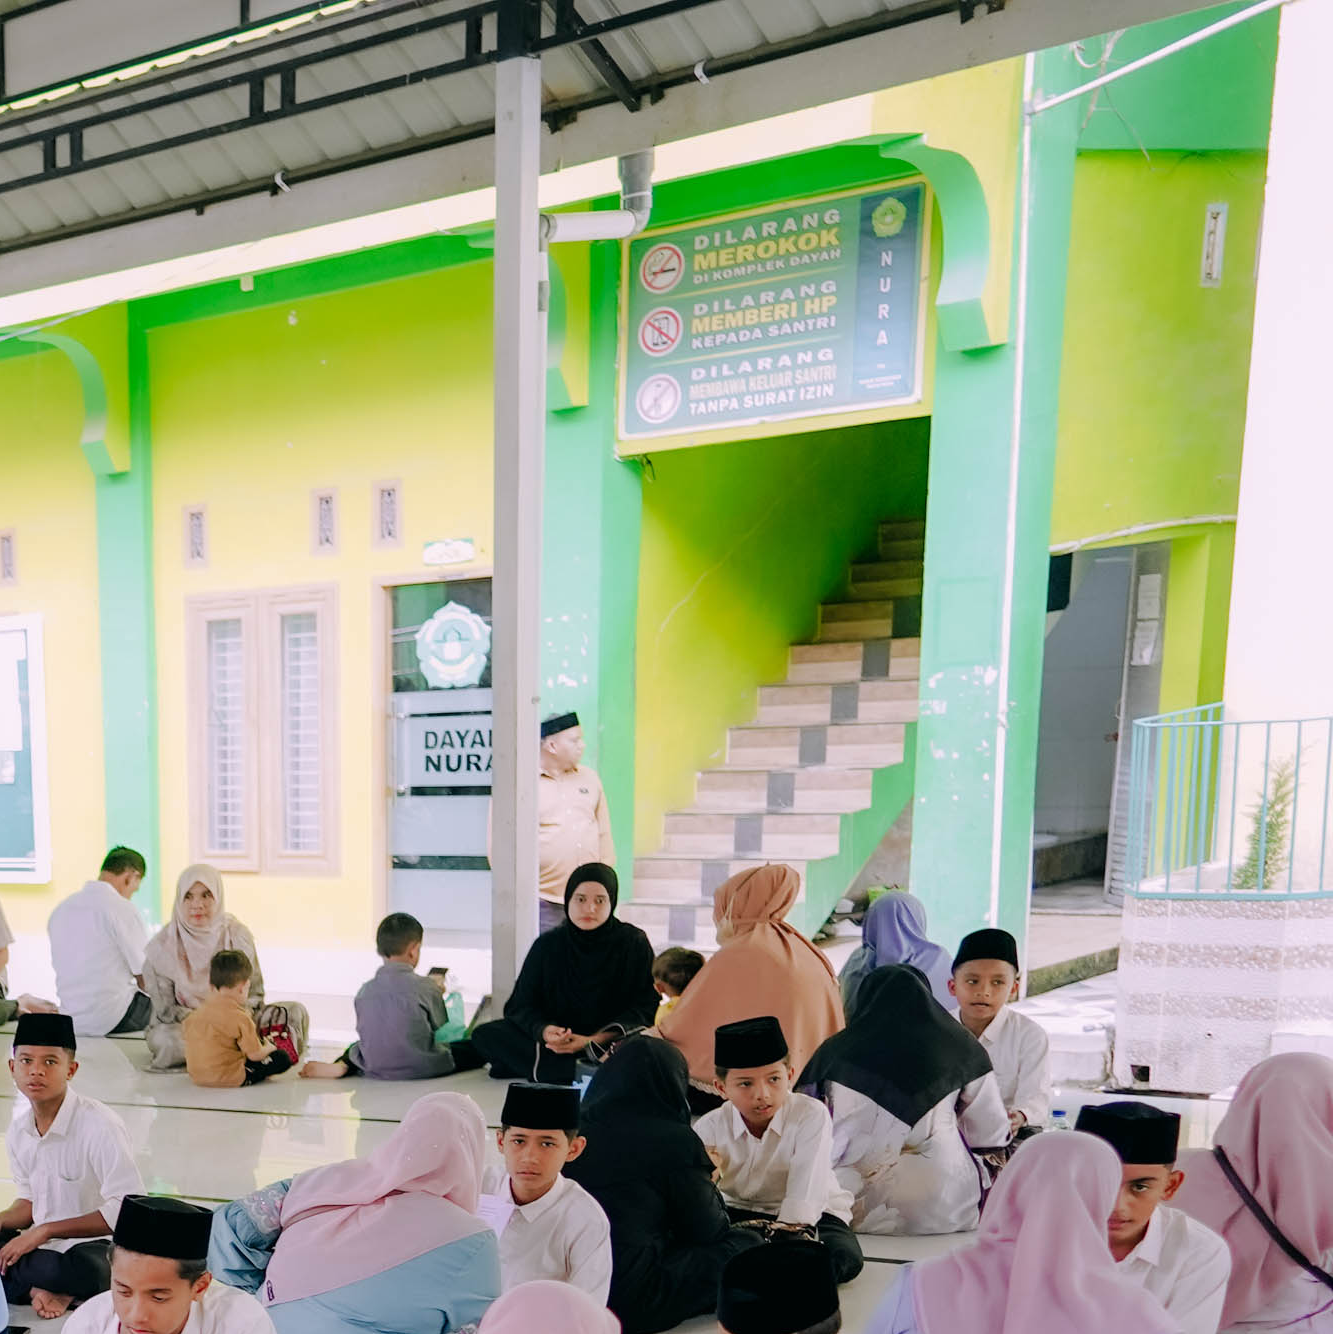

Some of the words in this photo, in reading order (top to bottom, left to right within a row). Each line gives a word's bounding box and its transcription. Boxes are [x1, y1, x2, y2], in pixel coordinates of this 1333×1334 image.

[694, 209, 841, 250] DILARANG
[693, 227, 840, 272] MEROKOK
[693, 273, 709, 284] DI
[713, 259, 785, 281] KOMPLEK
[789, 248, 841, 266] DAYAH
[691, 301, 798, 335] MEMBERI
[804, 295, 837, 316] HP
[693, 280, 837, 316] DILARANG
[691, 328, 763, 349] KEPADA
[768, 315, 836, 337] SANTRI
[691, 348, 834, 380] DILARANG
[689, 398, 739, 416] TANPA
[743, 389, 795, 408] SURAT
[799, 383, 834, 400] IZIN
[425, 729, 493, 749] DAYA
